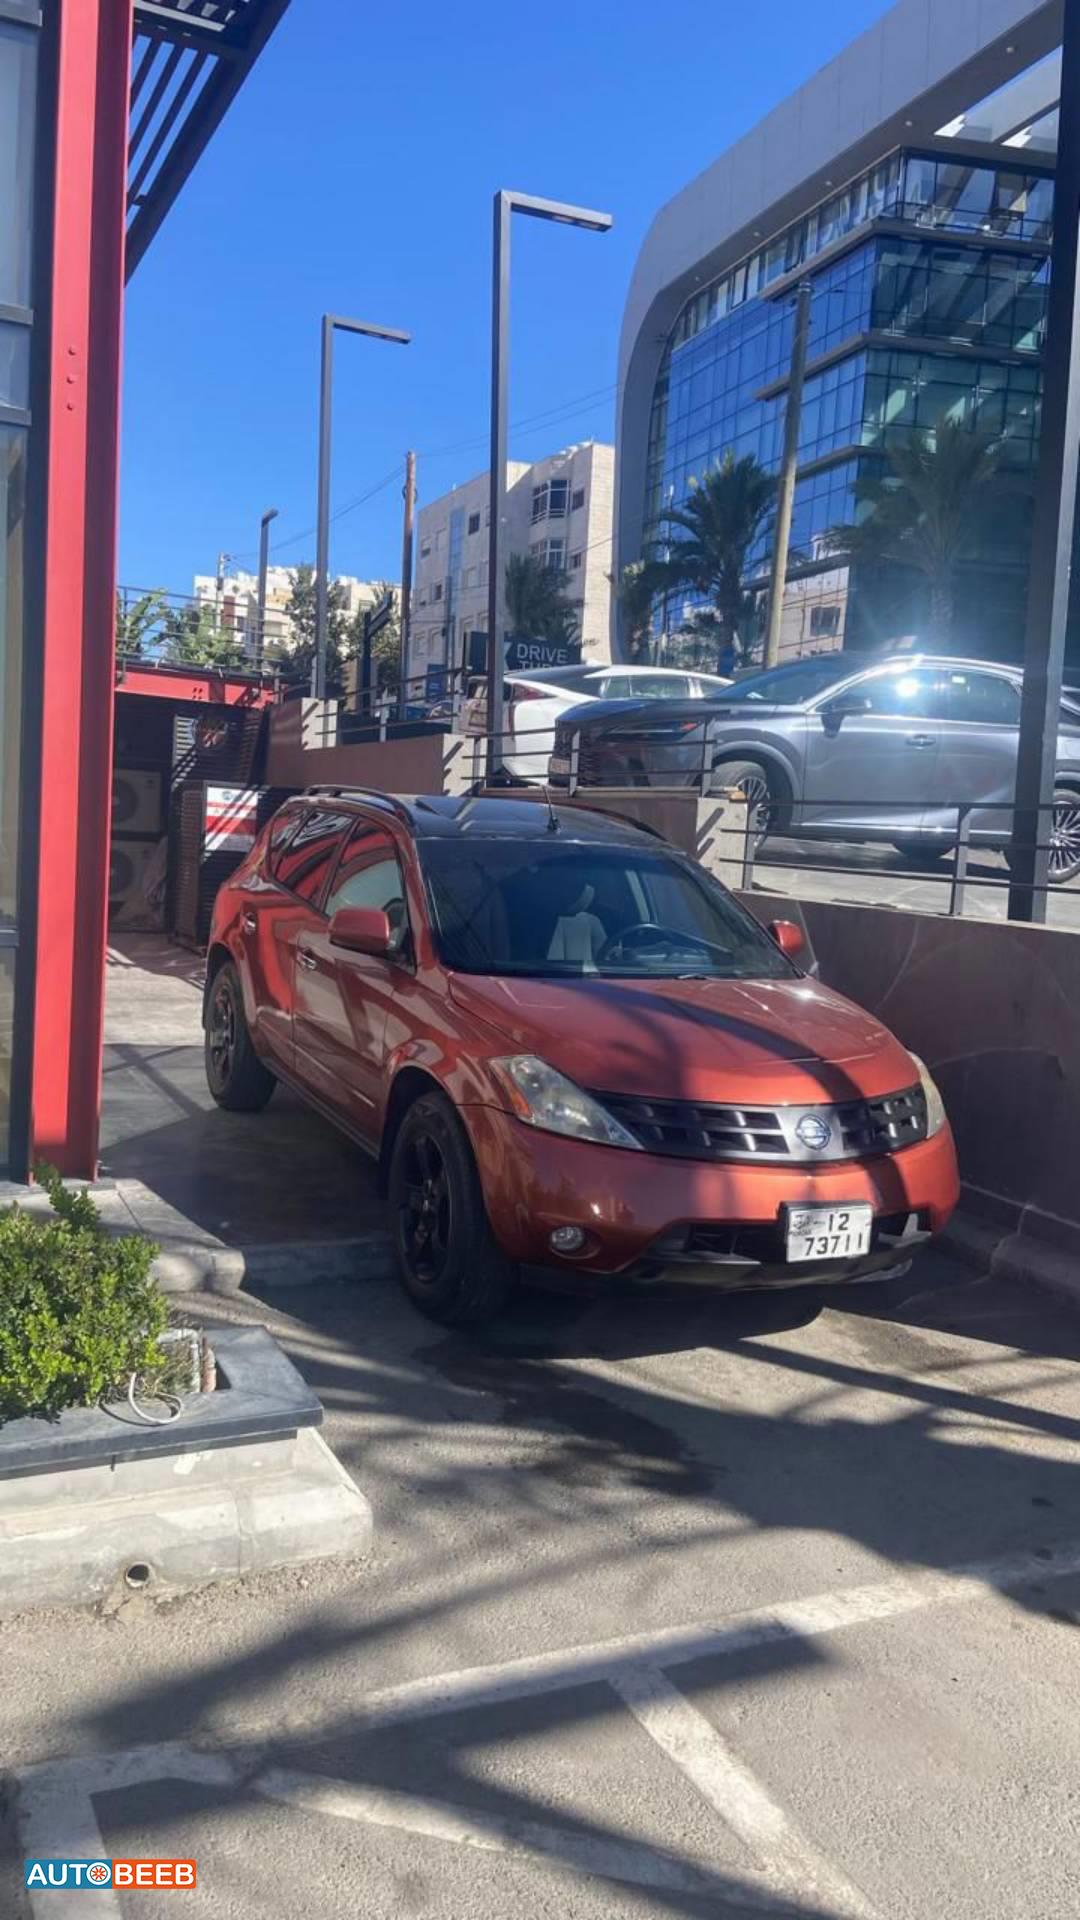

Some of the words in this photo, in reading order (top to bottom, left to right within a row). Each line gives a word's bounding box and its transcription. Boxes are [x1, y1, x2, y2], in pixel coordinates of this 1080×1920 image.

[516, 643, 568, 664] DRIVE
[828, 1213, 850, 1232] 12
[804, 1232, 862, 1256] 73711
